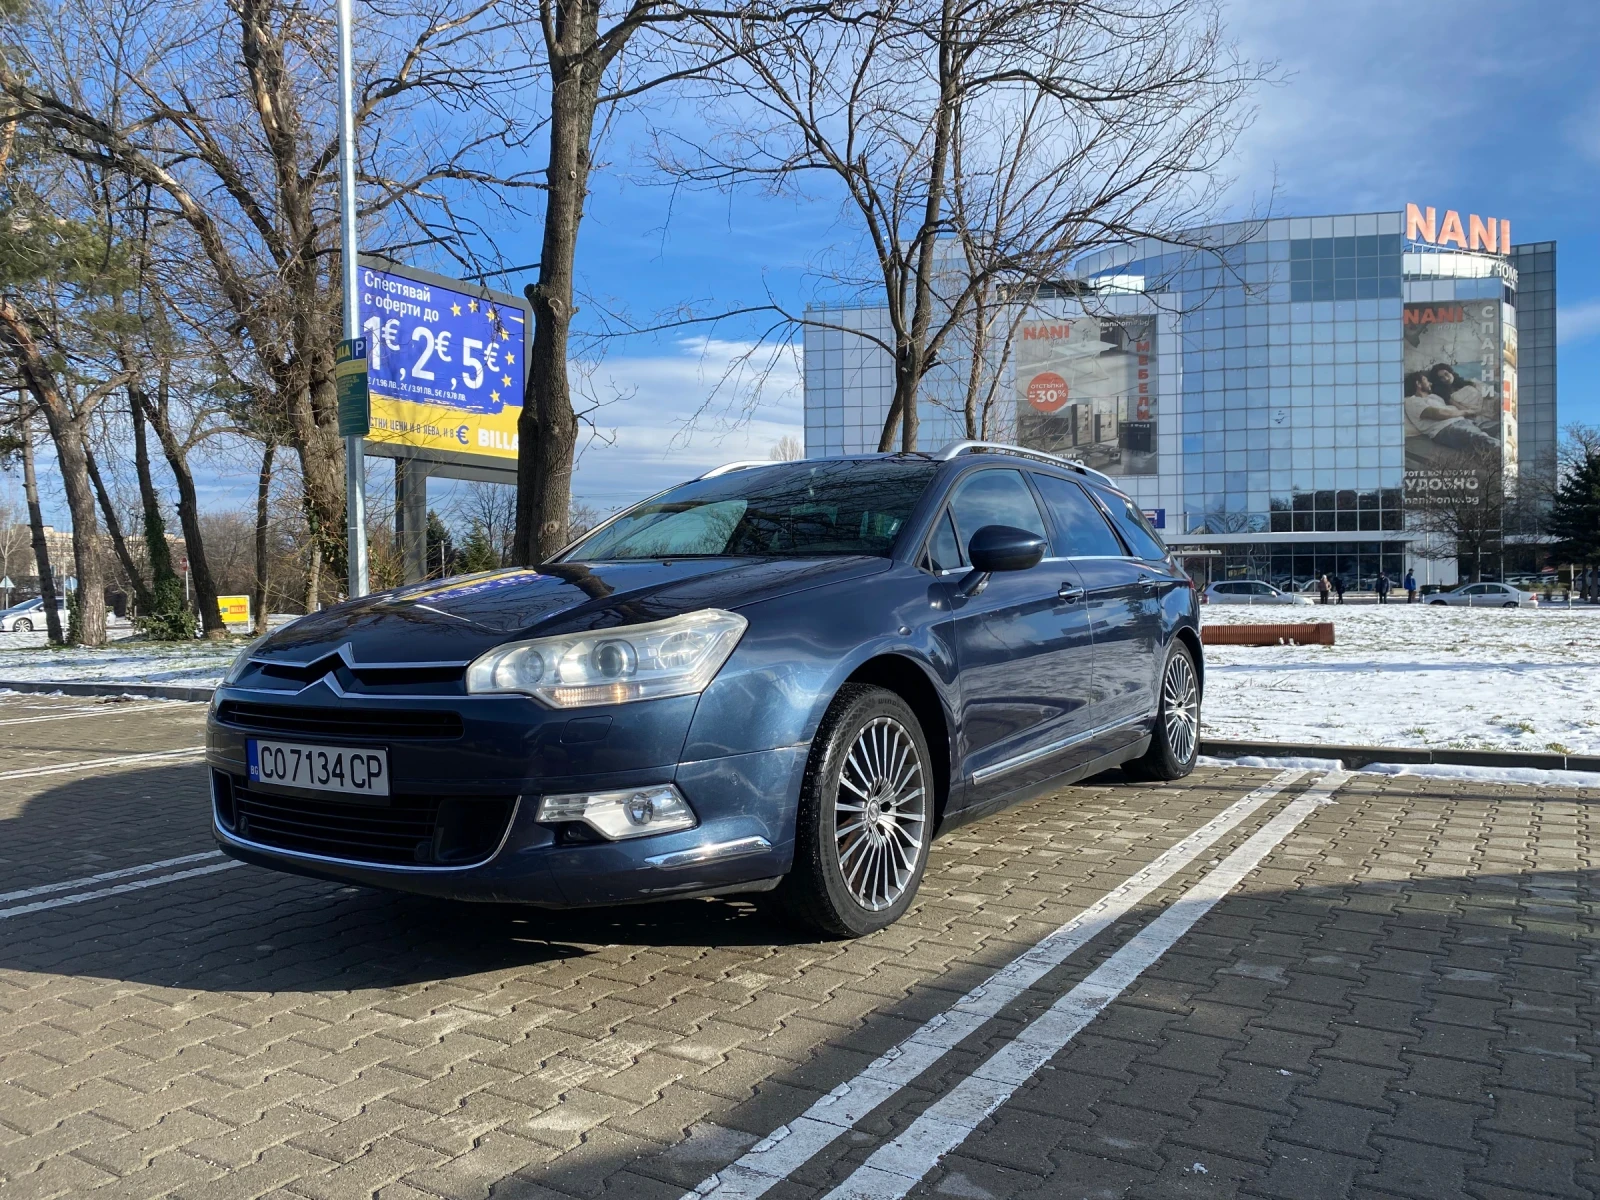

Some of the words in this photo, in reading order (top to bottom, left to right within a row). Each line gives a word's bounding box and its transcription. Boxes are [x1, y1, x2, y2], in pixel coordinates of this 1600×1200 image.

[1406, 203, 1511, 254] NANI
[365, 271, 430, 302] Спестявай
[364, 293, 372, 305] с
[375, 293, 421, 318] оферти
[423, 307, 439, 323] до
[1404, 307, 1463, 324] NANI
[1024, 326, 1069, 340] NANI
[355, 340, 364, 357] P
[1481, 305, 1495, 398] СПАЛНИ
[390, 420, 408, 432] ЦЕНИ
[1405, 477, 1479, 493] УДОБНО
[250, 764, 259, 776] BG
